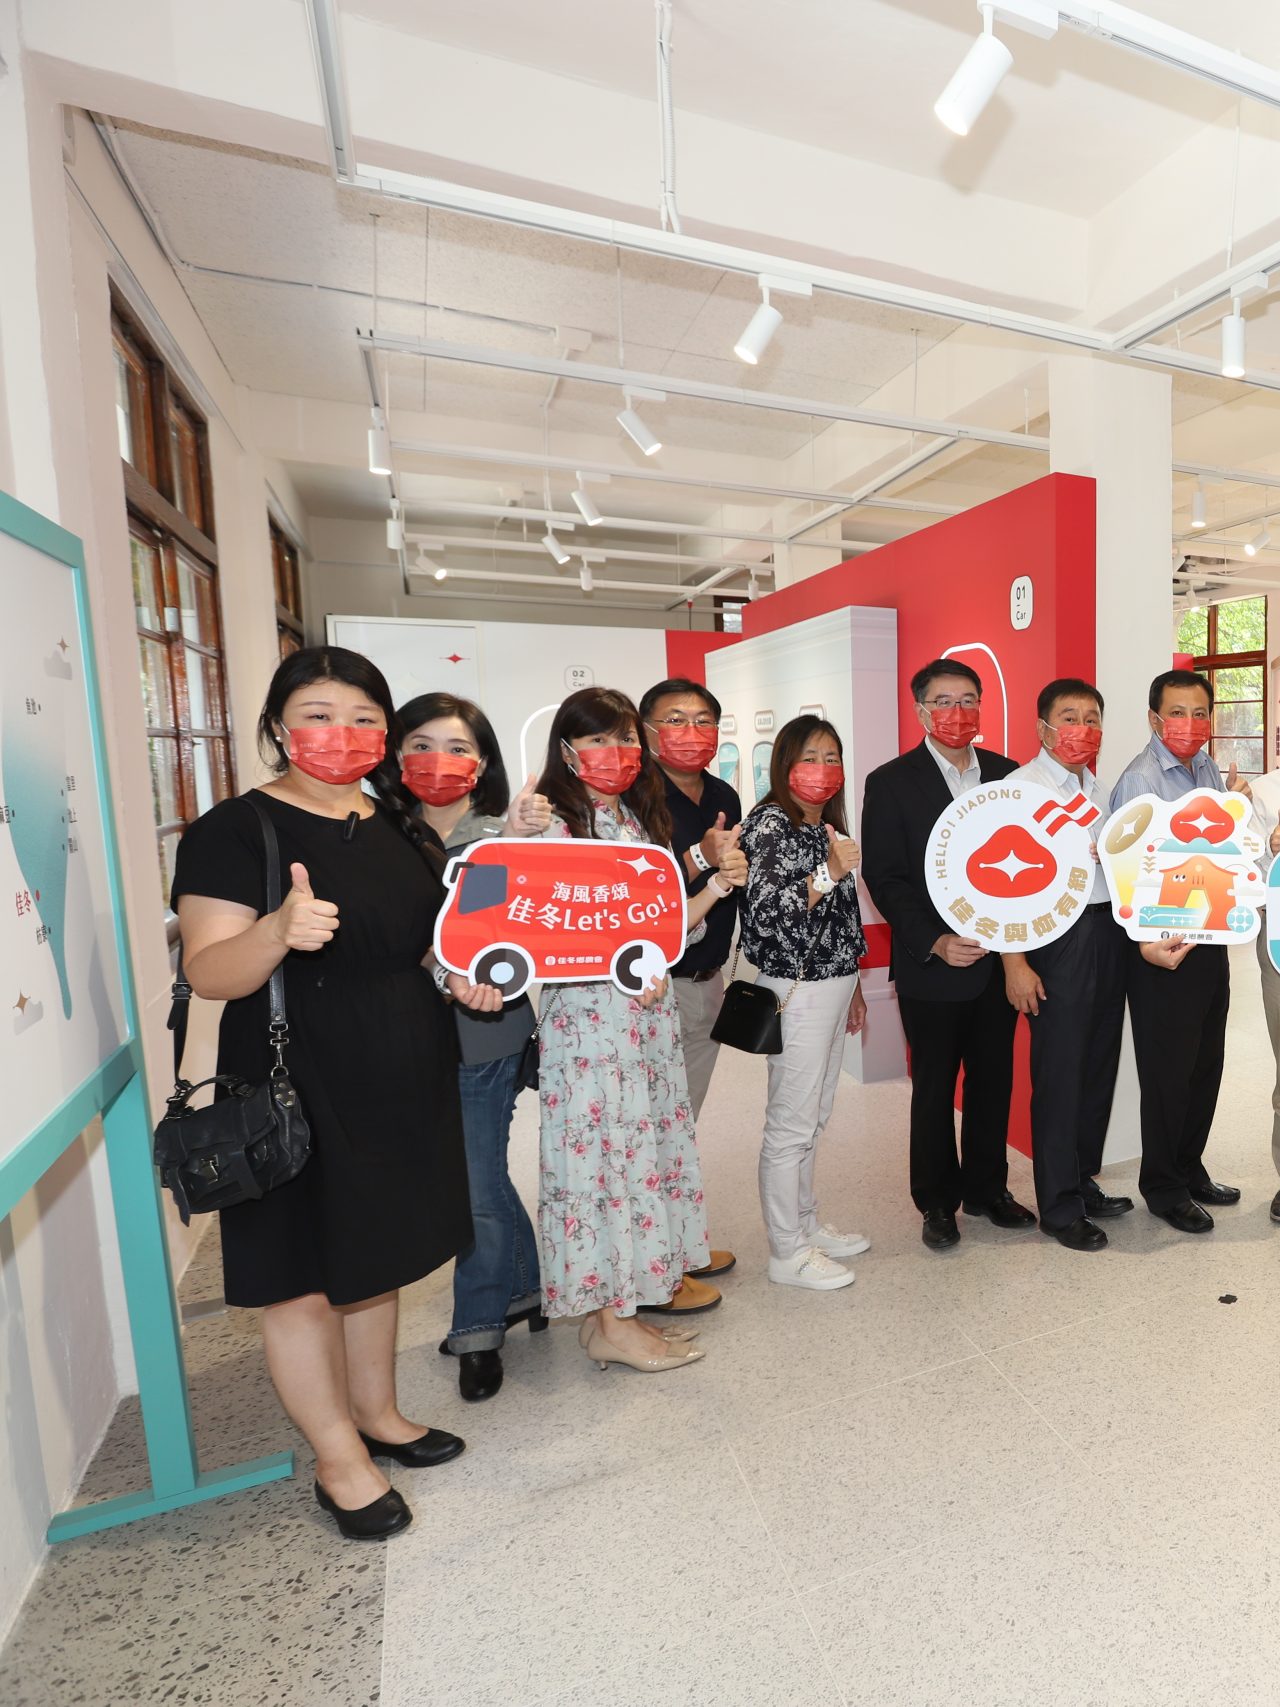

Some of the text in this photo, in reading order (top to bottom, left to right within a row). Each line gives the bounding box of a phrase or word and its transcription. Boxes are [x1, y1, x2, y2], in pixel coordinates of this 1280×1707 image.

[1016, 585, 1026, 600] 01
[1016, 611, 1026, 620] Car
[572, 670, 585, 678] 02
[935, 827, 952, 880] HELLO
[956, 788, 1022, 820] JIADONG
[16, 890, 31, 917] 佳冬
[551, 881, 631, 904] 海風香頌
[948, 866, 1088, 943] 佳冬與你有約
[627, 894, 668, 925] Go!
